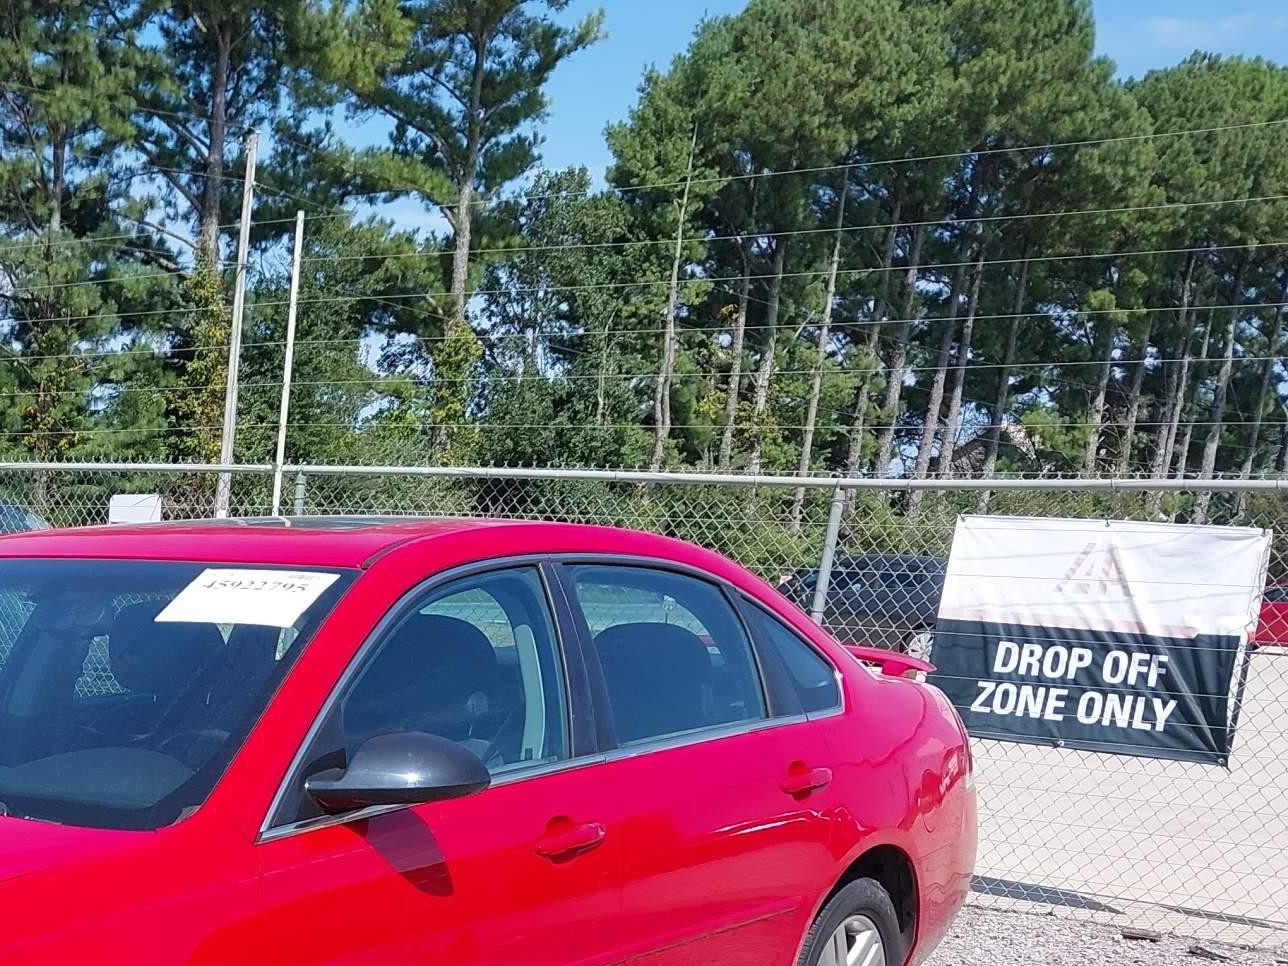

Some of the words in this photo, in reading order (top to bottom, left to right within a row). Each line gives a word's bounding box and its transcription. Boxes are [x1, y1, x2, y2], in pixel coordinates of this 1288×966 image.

[203, 580, 309, 593] 45922795
[993, 641, 1094, 680] DROP
[1102, 650, 1169, 689] OFF
[970, 681, 1069, 721] ZONE
[1077, 690, 1178, 732] ONLY
